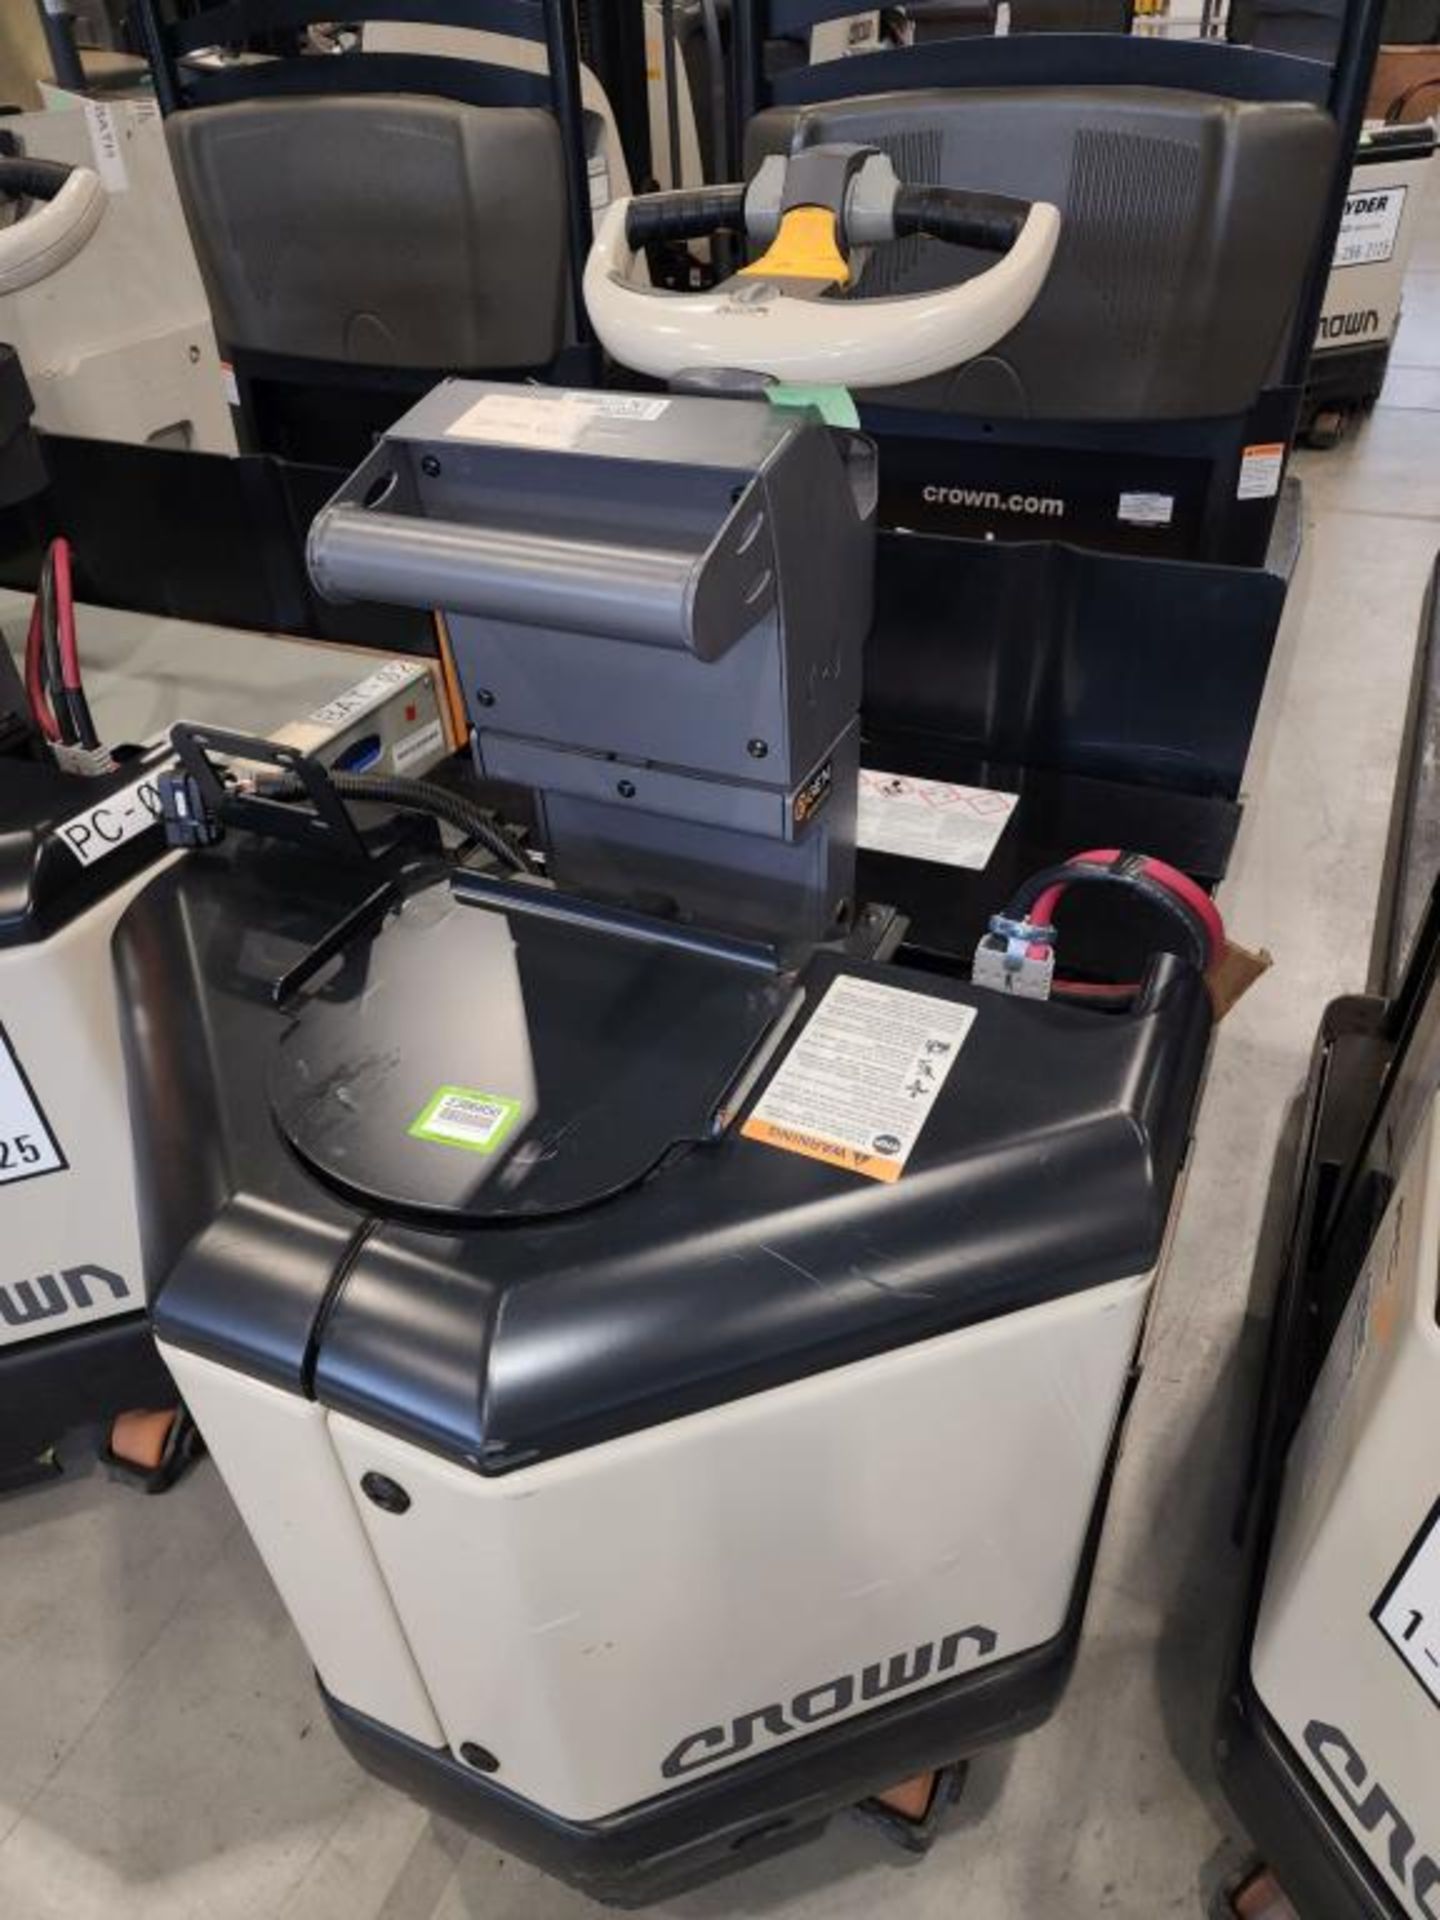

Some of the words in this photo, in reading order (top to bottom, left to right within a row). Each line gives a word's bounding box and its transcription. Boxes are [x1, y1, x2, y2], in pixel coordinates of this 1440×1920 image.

[1345, 195, 1389, 216] YDER
[1320, 310, 1379, 339] ROWN
[922, 484, 1065, 516] crown.com
[768, 1125, 848, 1159] WARNING
